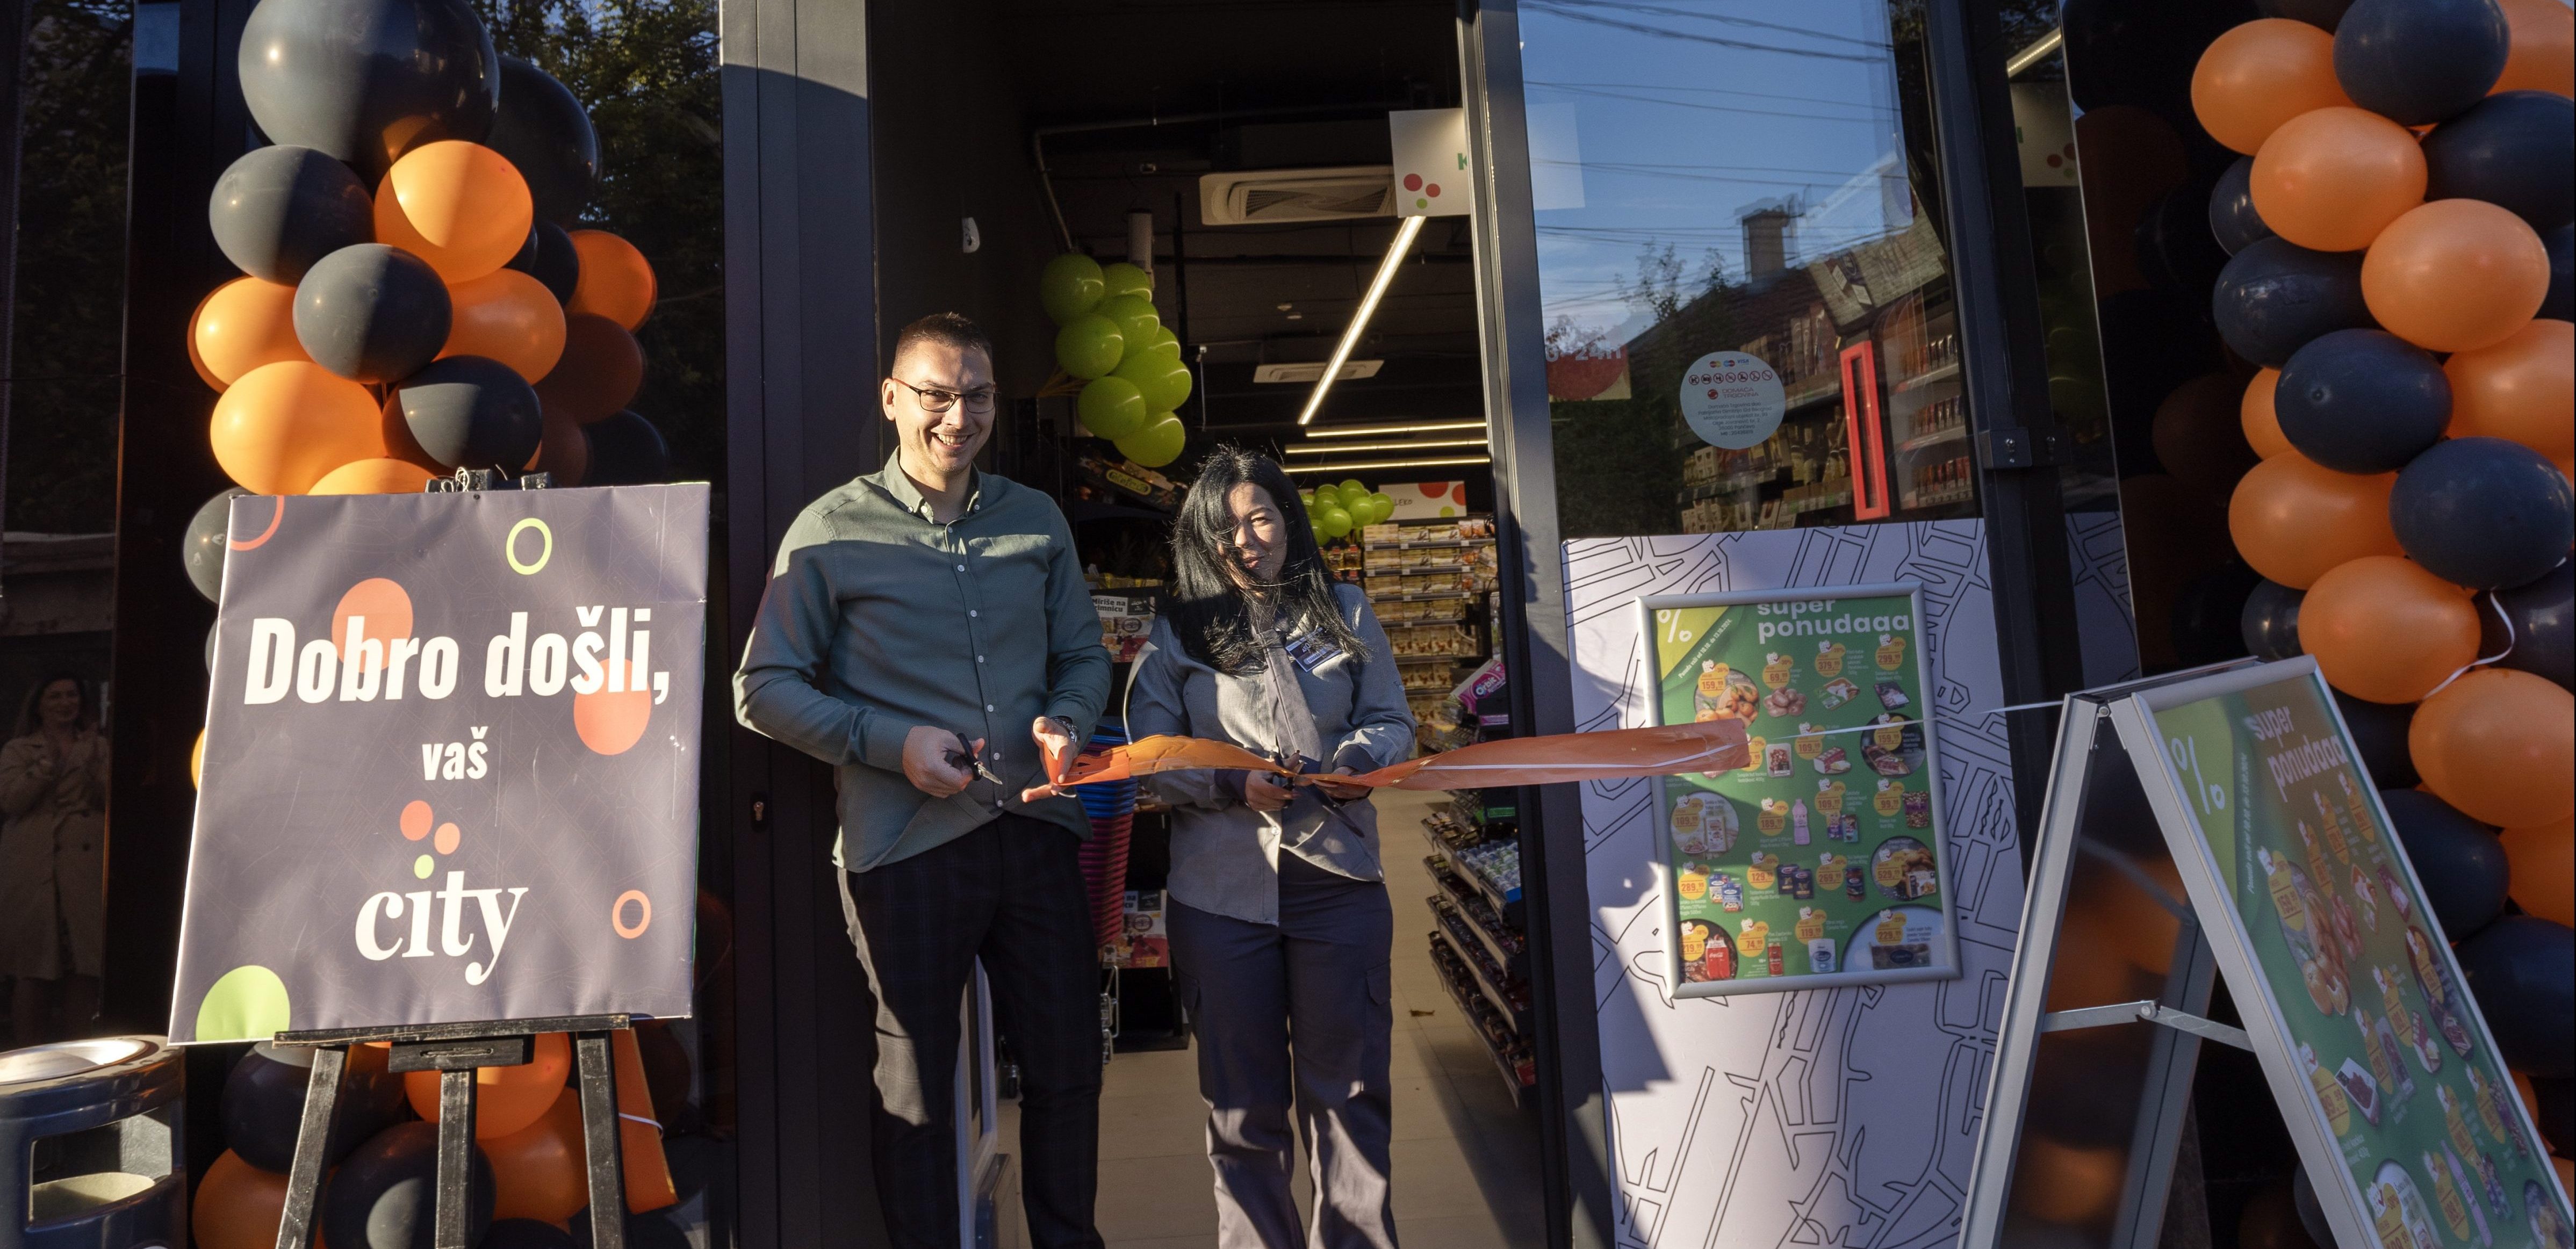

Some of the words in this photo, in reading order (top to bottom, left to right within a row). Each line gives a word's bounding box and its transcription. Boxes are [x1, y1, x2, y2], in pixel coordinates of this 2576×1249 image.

[1757, 600, 1836, 619] super
[1758, 613, 1909, 644] ponudaaa
[244, 615, 458, 705] Dobro
[484, 605, 671, 705] došli,
[1476, 677, 1498, 696] Orbit
[2249, 705, 2296, 749] super
[422, 726, 488, 780] vaš
[2267, 733, 2349, 803] ponudaaa
[355, 855, 529, 985] city
